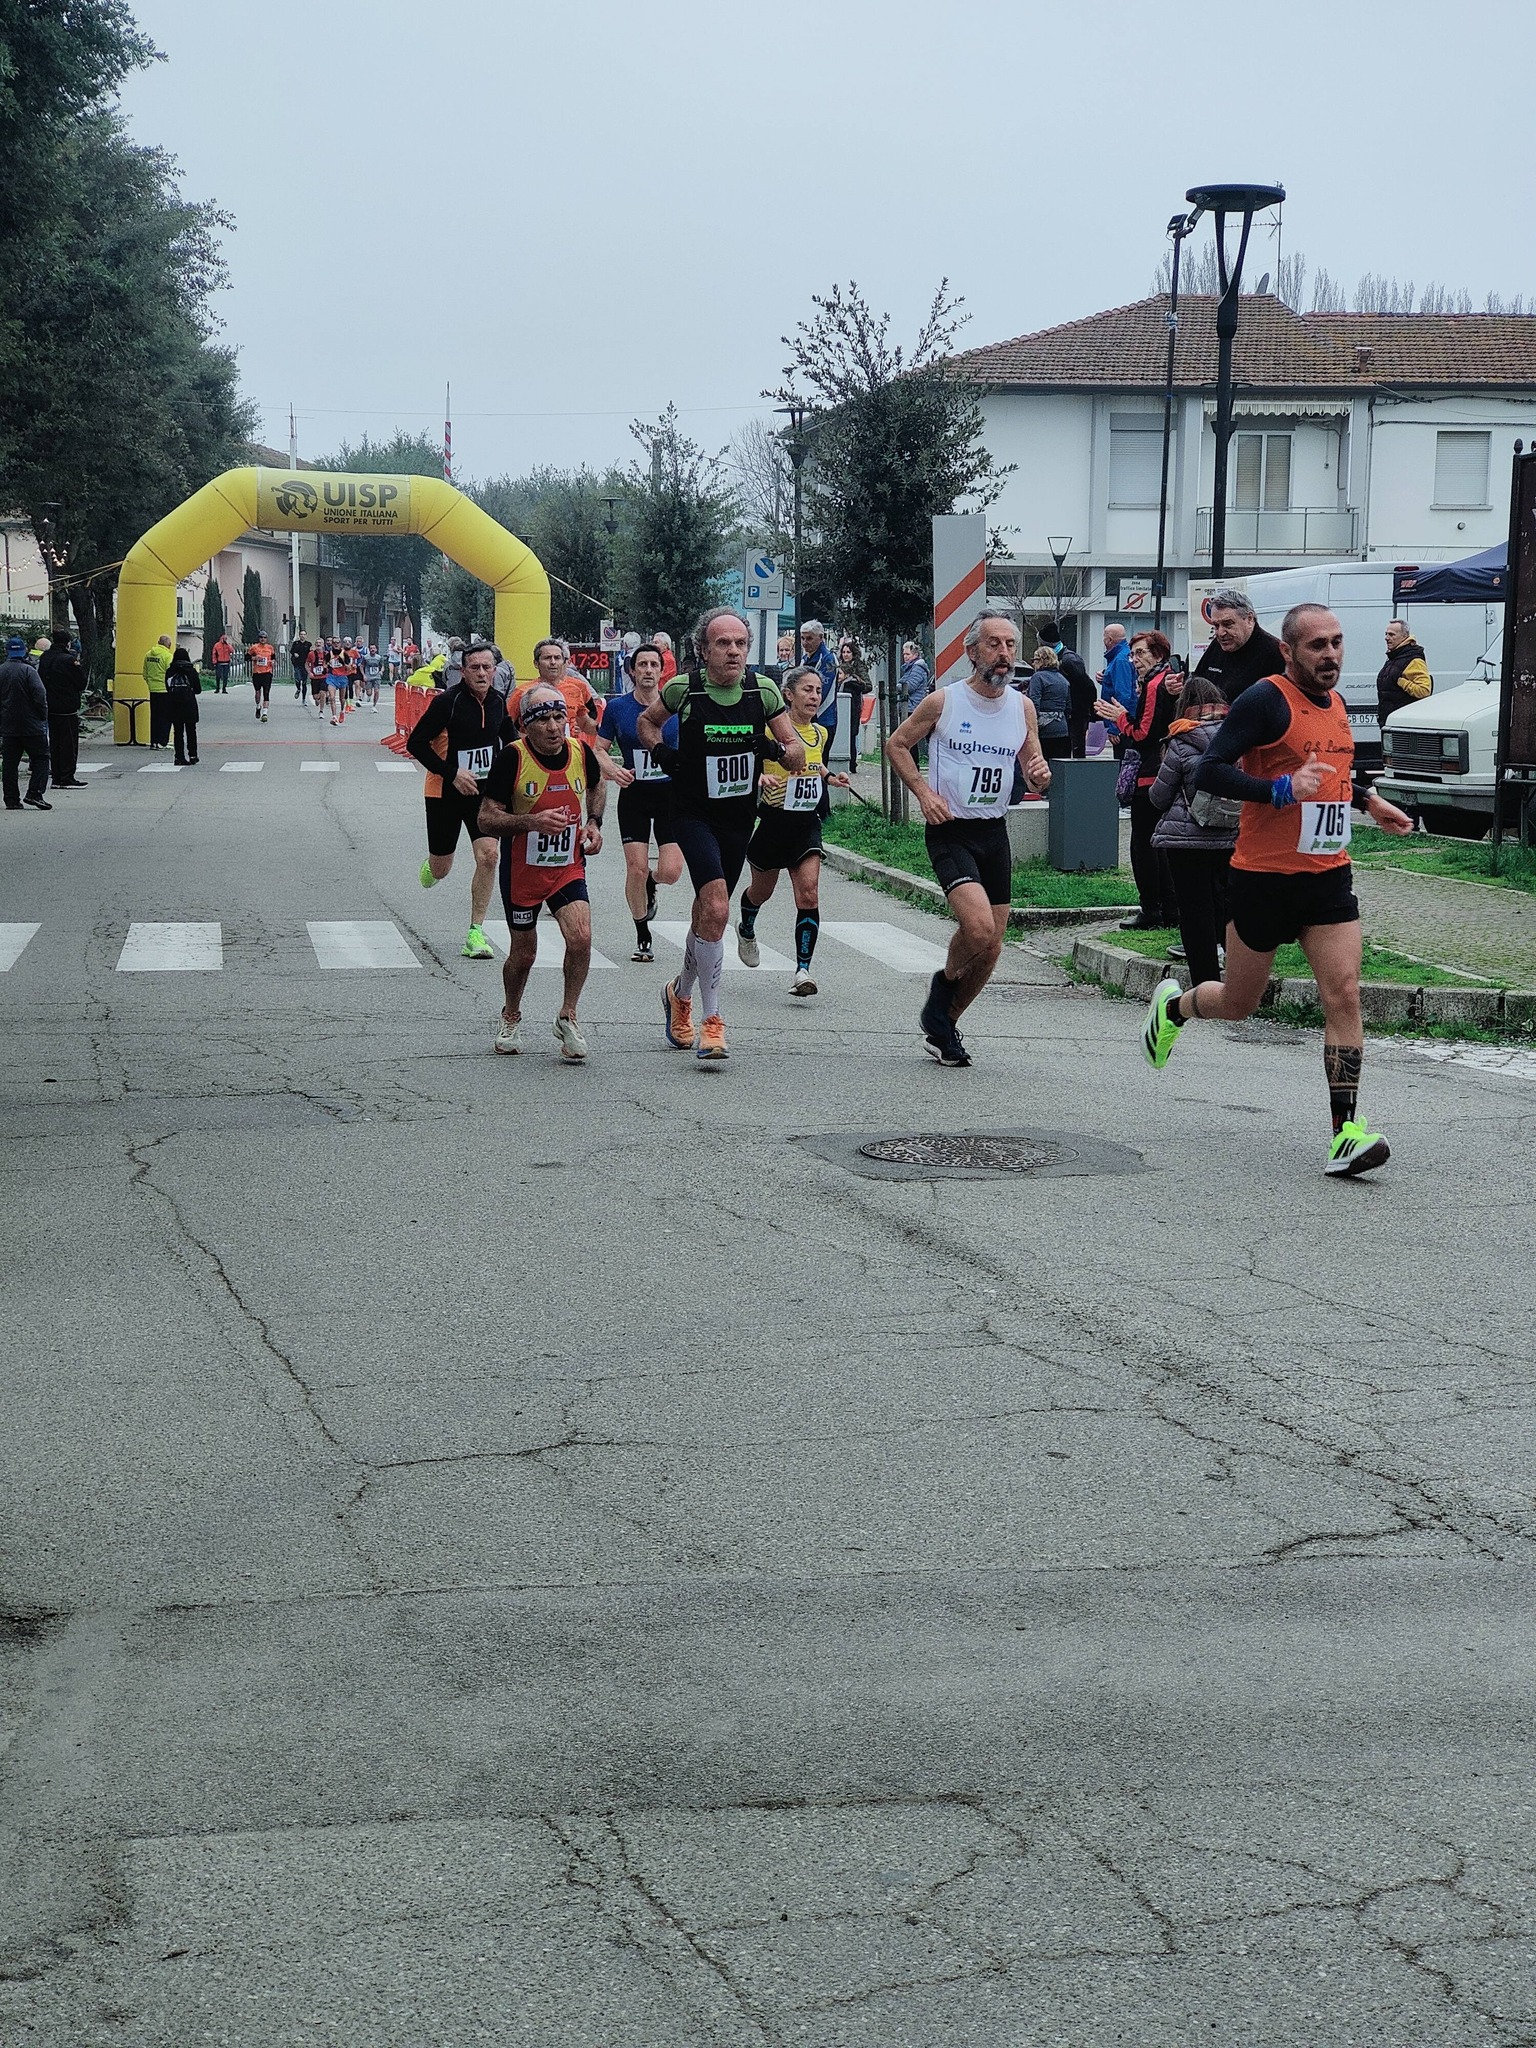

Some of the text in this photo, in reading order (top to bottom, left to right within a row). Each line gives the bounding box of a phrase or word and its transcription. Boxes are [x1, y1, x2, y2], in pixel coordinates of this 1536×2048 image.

[323, 482, 398, 508] UISP
[323, 508, 398, 518] UNIONE ITALIANA
[323, 516, 350, 524] SPORT
[372, 518, 393, 526] TUTTI
[467, 748, 490, 770] 740
[948, 738, 1017, 758] lughesina
[717, 754, 750, 784] 800
[970, 766, 1003, 794] 793
[794, 777, 818, 800] 655
[1314, 803, 1346, 837] 705
[537, 826, 571, 853] 548
